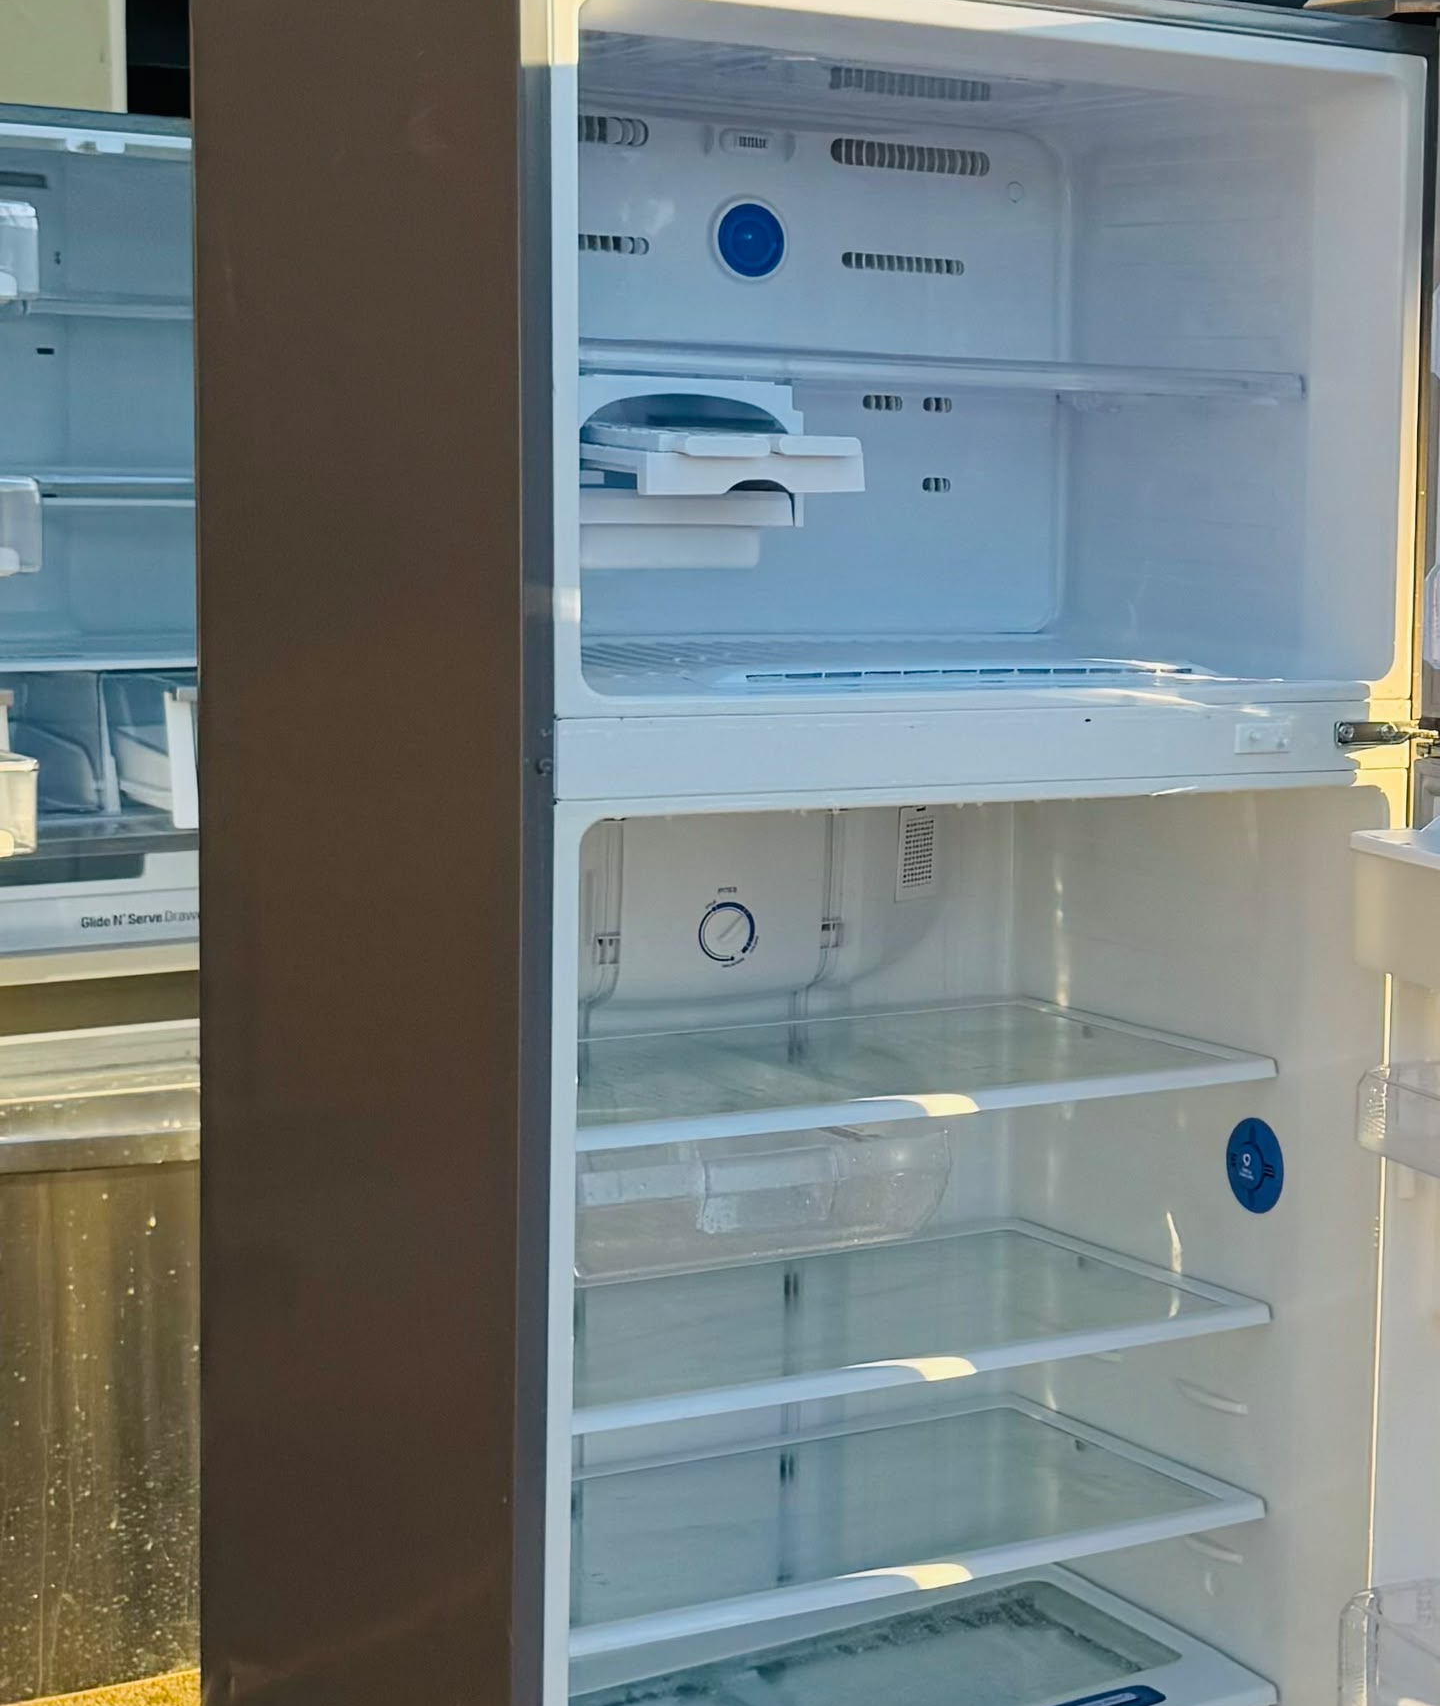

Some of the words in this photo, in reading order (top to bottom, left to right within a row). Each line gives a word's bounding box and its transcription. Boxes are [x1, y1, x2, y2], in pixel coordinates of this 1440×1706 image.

[81, 916, 111, 928] Glide
[128, 913, 163, 925] Serve
[165, 910, 200, 922] Draw
